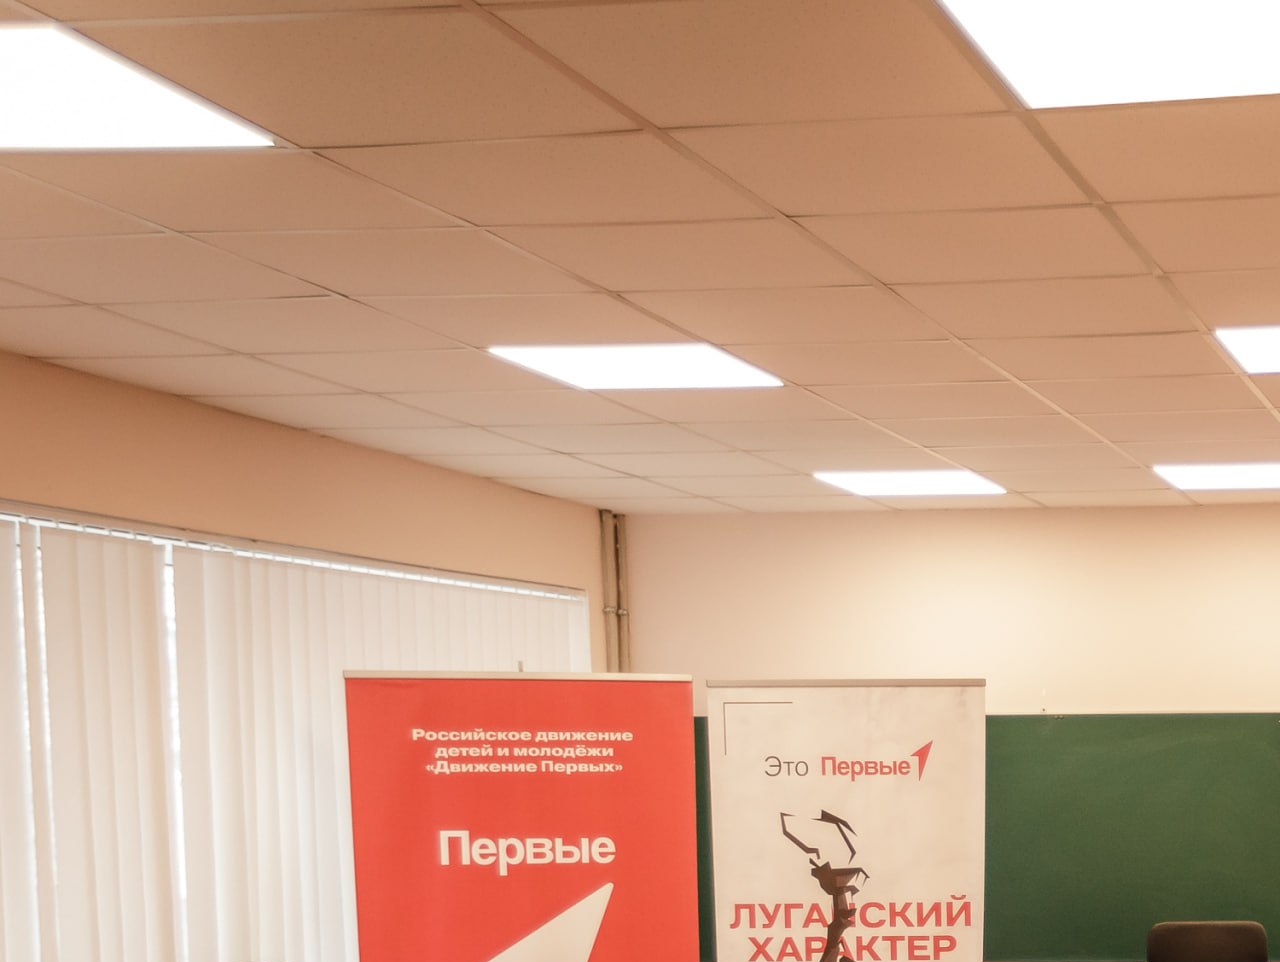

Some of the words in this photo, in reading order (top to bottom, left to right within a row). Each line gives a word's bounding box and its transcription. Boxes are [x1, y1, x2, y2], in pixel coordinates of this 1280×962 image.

[411, 728, 532, 741] Российское
[535, 731, 633, 742] движение
[434, 744, 493, 757] детей
[497, 747, 510, 757] и
[513, 744, 614, 757] молодёжи
[426, 760, 537, 775] «Движение
[541, 760, 623, 775] Первых»
[764, 756, 809, 777] Это
[821, 756, 911, 782] Первые
[439, 830, 616, 876] Первые
